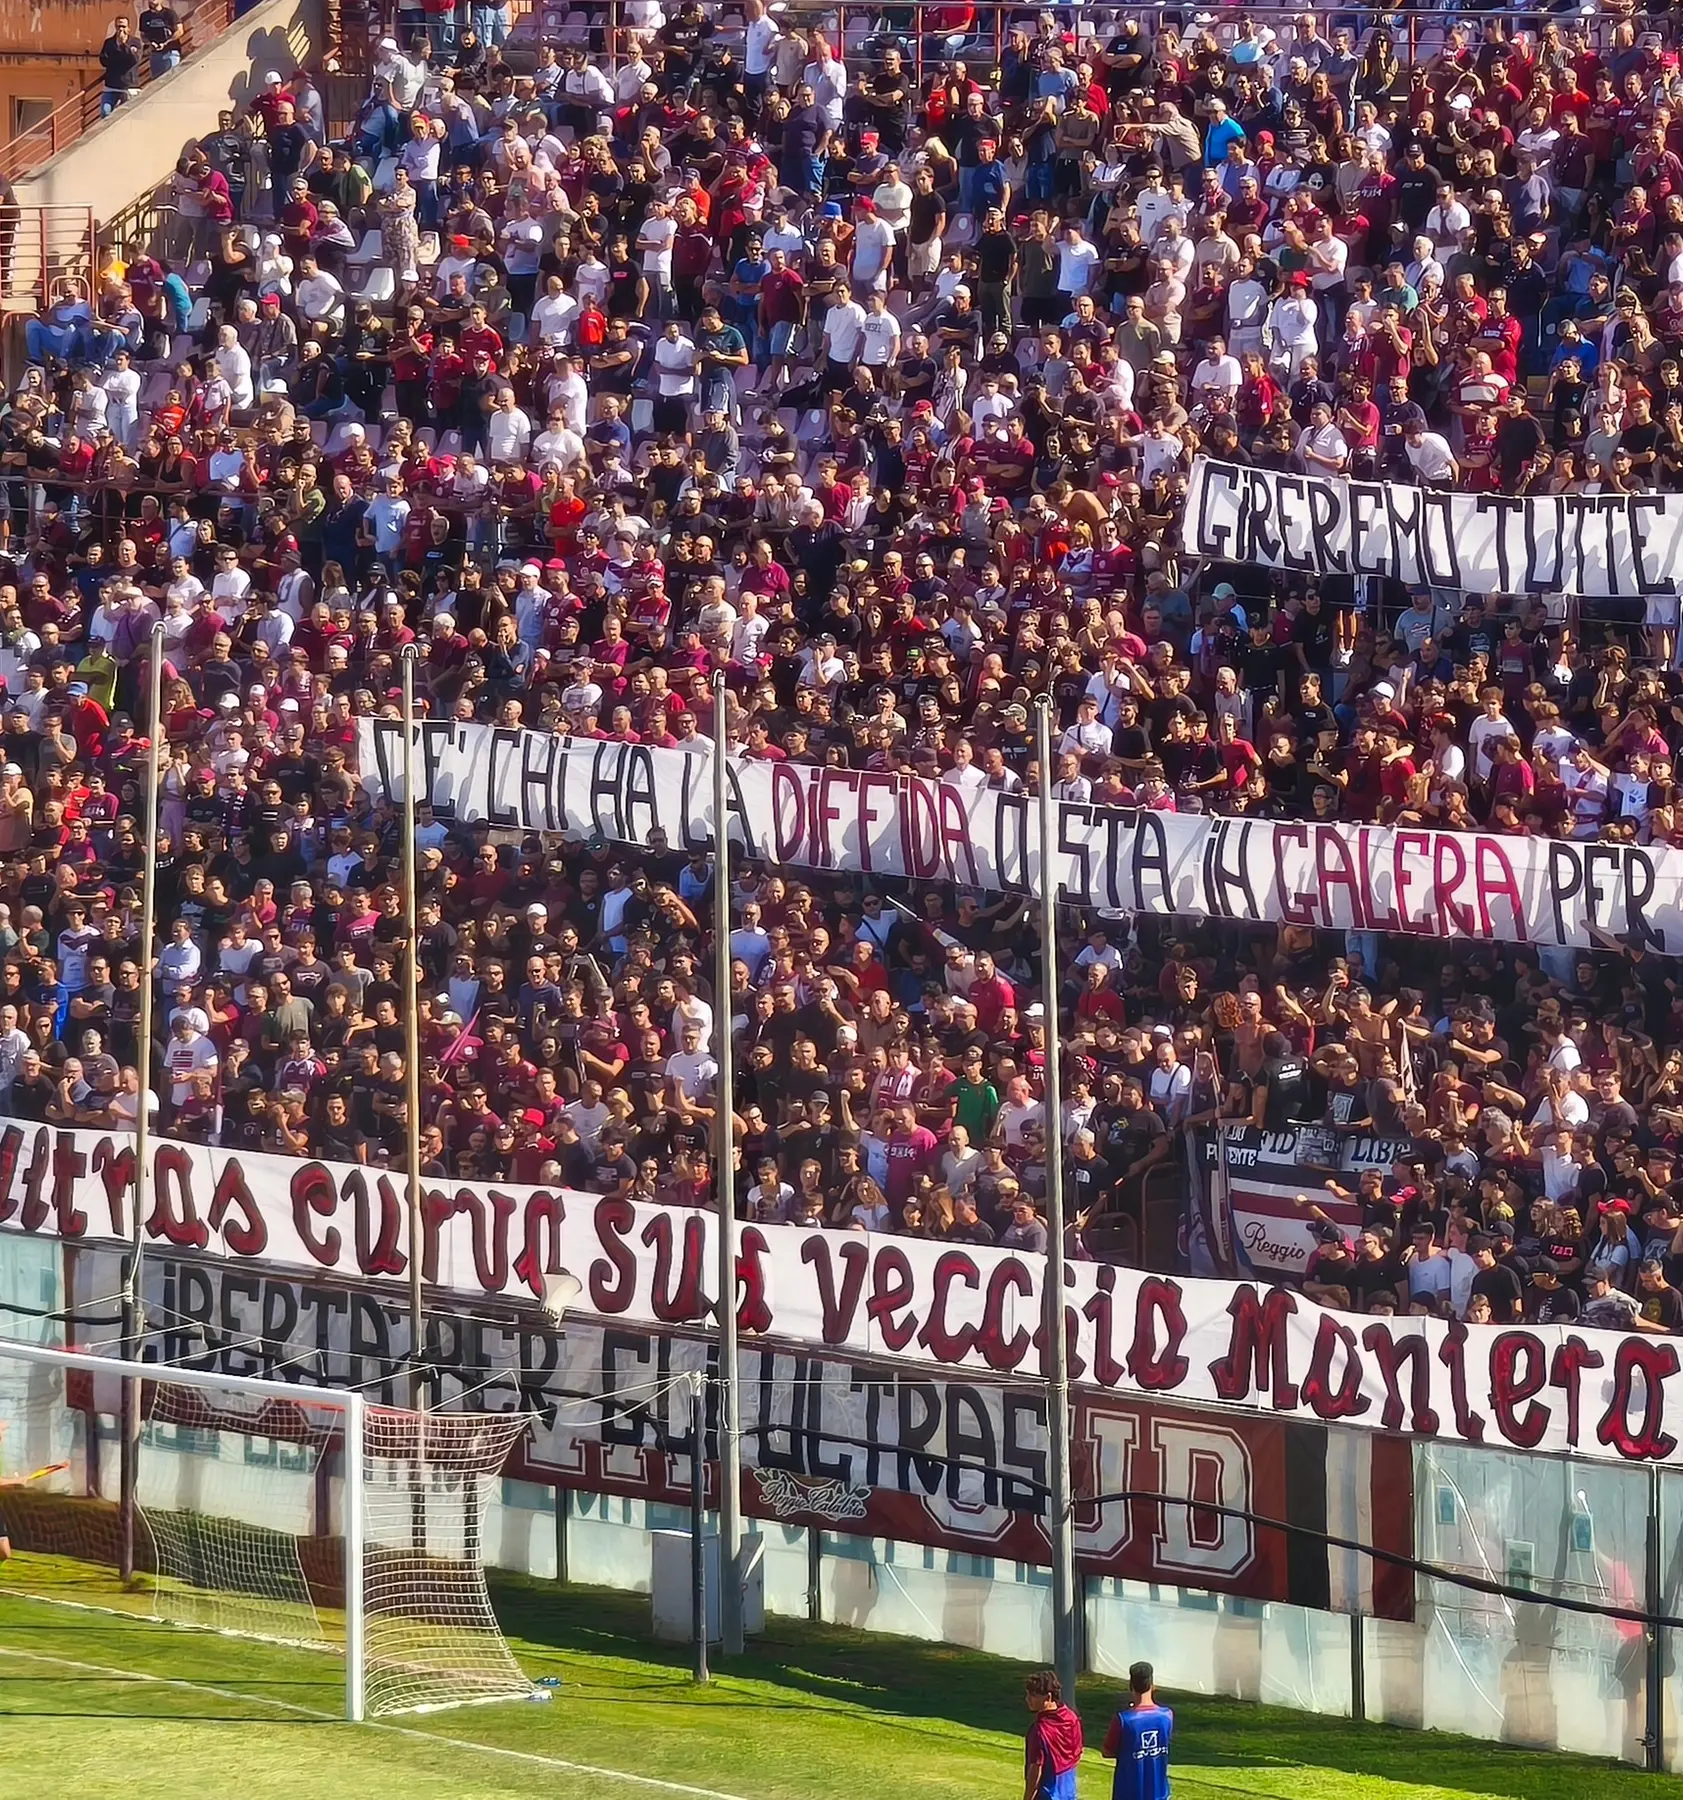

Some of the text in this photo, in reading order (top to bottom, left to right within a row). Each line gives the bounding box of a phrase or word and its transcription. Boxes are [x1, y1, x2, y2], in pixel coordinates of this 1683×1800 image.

[1476, 496, 1676, 596] TUTTE
[590, 744, 661, 843] HA
[995, 792, 1031, 897] O
[1057, 805, 1177, 914] STA
[1272, 823, 1528, 942] GALERA
[1548, 842, 1666, 954] PER
[1243, 1221, 1306, 1263] Reggio
[756, 1350, 1053, 1517] ULTRAS
